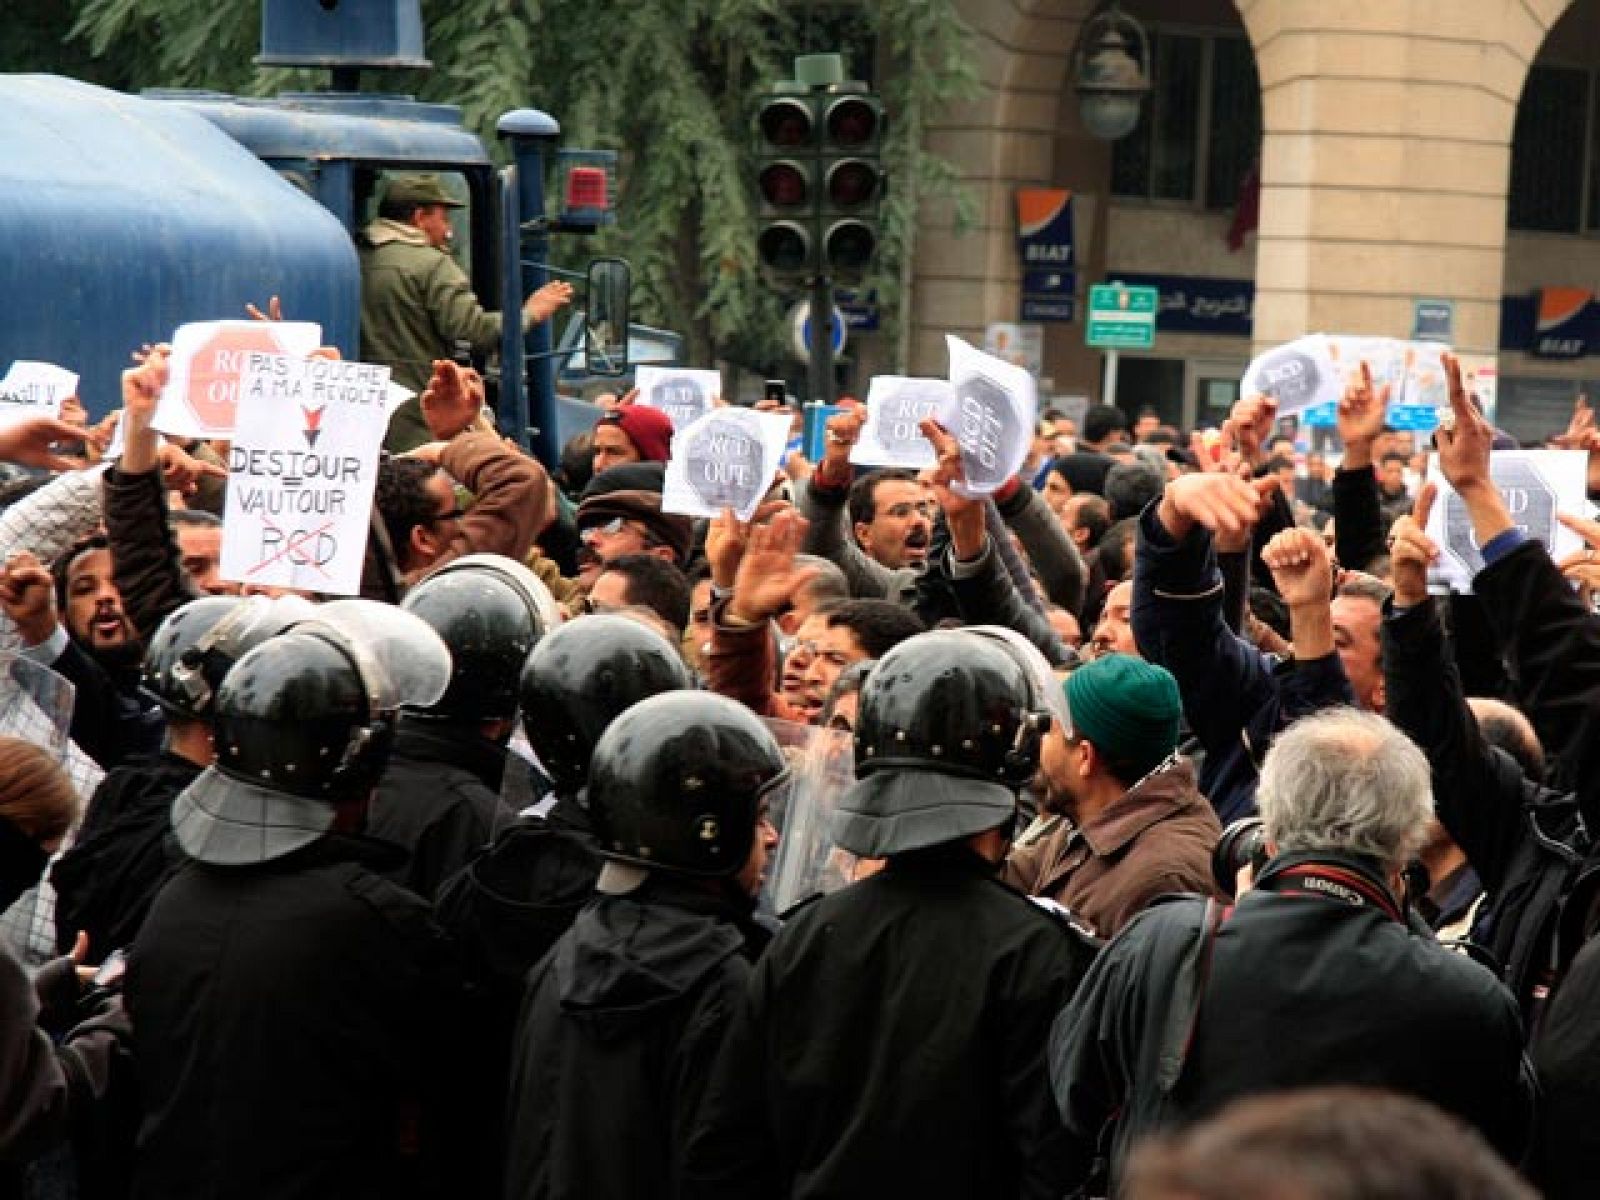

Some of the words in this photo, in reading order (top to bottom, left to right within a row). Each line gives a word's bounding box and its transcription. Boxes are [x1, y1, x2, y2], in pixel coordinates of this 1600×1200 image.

[1026, 245, 1071, 261] BIAT
[1539, 338, 1585, 353] BIAT
[249, 354, 290, 376] PAS
[302, 359, 381, 386] TOUCHE
[230, 446, 361, 483] DESTOUR
[237, 486, 346, 515] VAUTOUR
[260, 526, 338, 566] RCD
[1304, 876, 1364, 906] Canon
